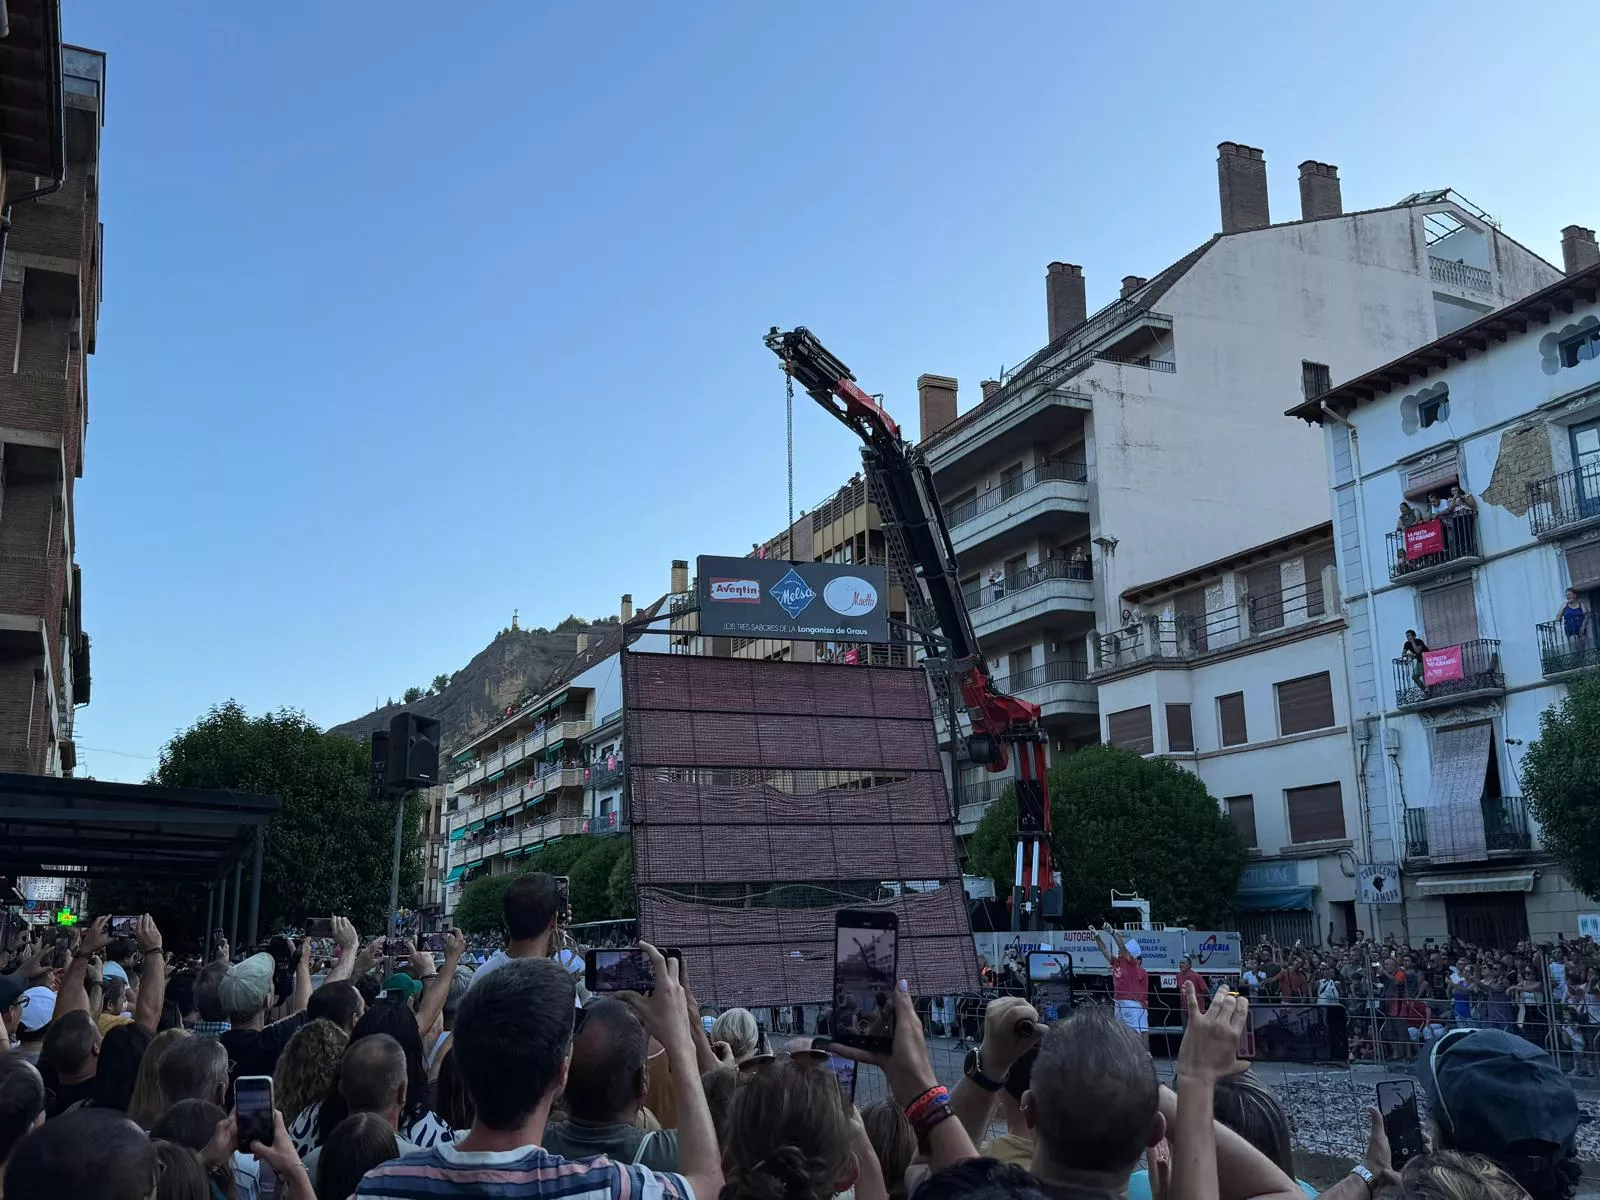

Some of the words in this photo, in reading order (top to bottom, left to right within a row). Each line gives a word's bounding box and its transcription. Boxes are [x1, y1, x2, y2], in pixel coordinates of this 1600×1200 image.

[779, 587, 815, 605] Melsa
[737, 623, 751, 631] TRES
[751, 624, 778, 632] SABORES
[797, 626, 835, 635] Longaniza
[836, 627, 846, 635] de
[1063, 932, 1097, 942] AUTOGRU
[1199, 943, 1230, 952] CLAVERIA
